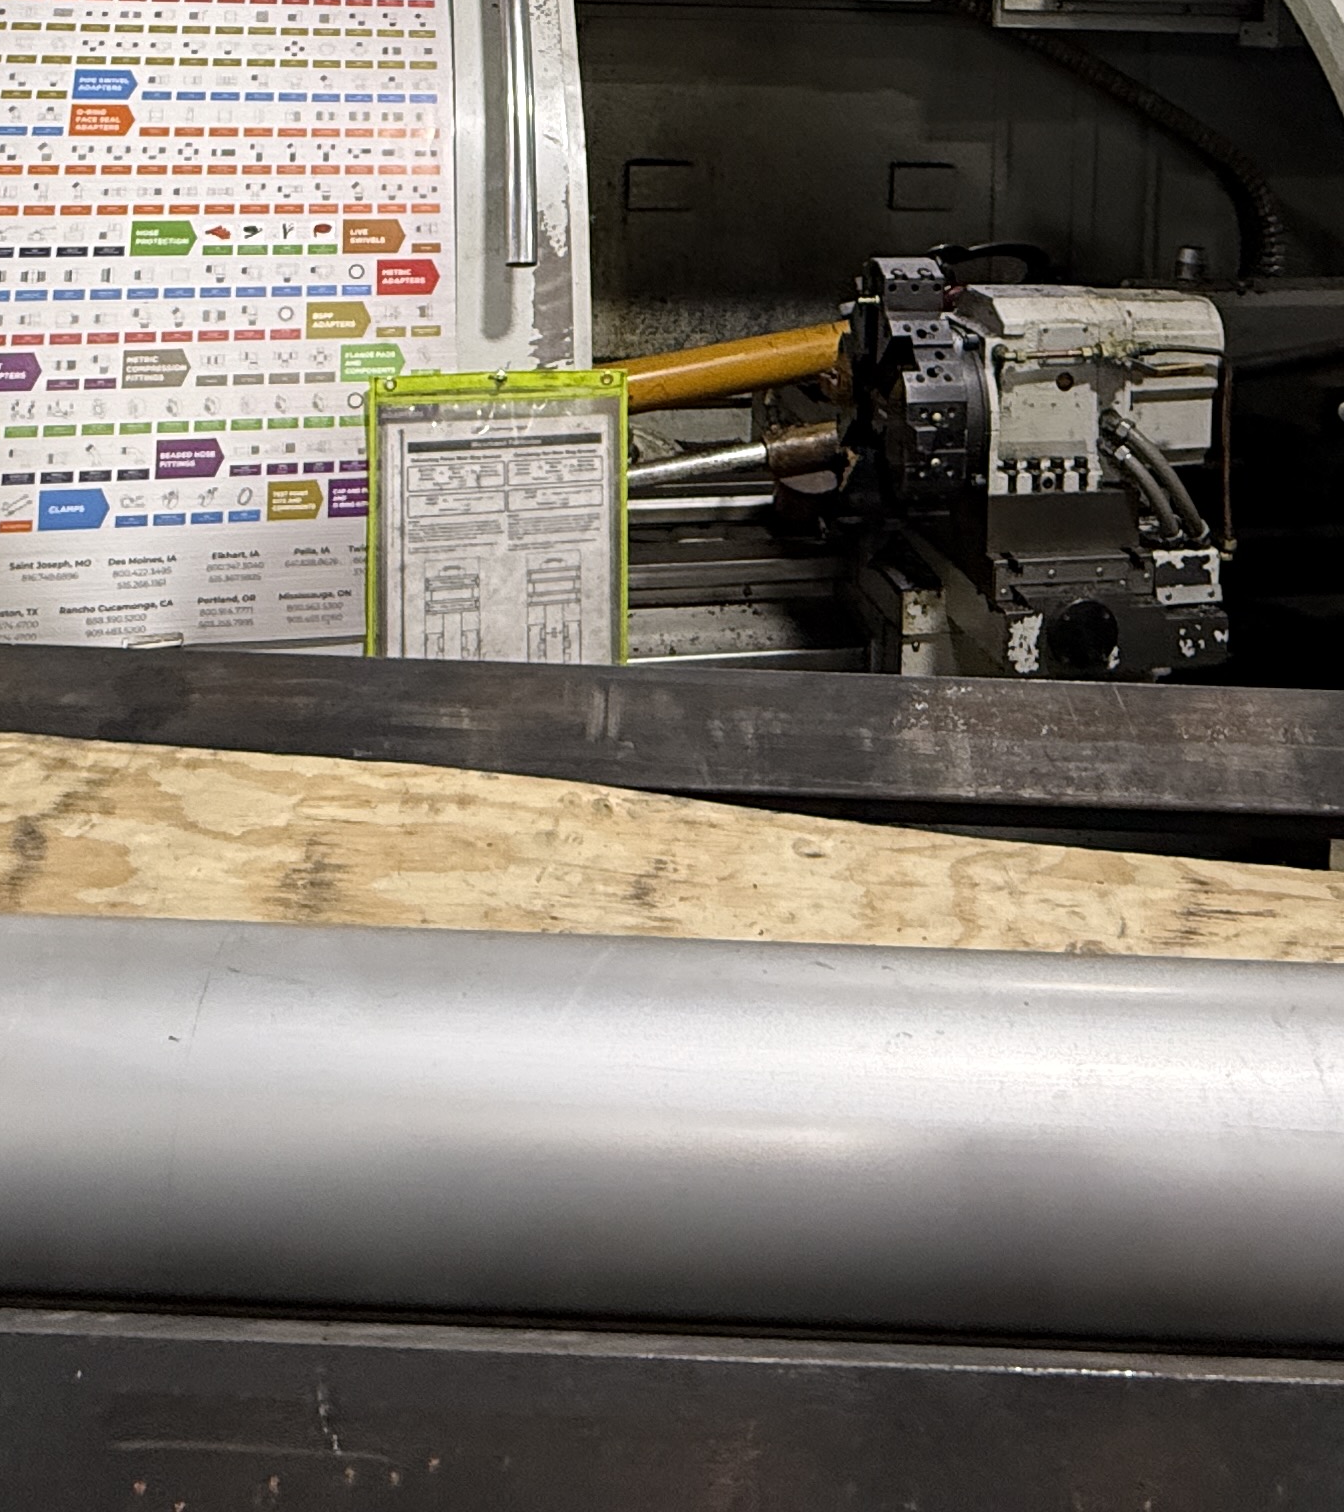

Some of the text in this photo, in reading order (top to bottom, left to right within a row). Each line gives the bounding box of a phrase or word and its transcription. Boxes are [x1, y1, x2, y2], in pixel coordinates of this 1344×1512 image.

[349, 228, 368, 236] LIVE
[134, 236, 189, 245] PROTECTION
[350, 236, 386, 244] SWIVELS
[382, 268, 412, 276] METRIC
[382, 276, 426, 285] ADAPTERS
[311, 320, 356, 329] ADAPTERS
[126, 355, 159, 364] METRIC
[126, 364, 188, 373] COMPRESSION
[344, 366, 396, 376] COMPONENTS
[125, 373, 164, 382] FITTINGS
[159, 450, 216, 460] BEADED HOSE
[159, 459, 196, 468] FITTINGS
[48, 504, 85, 515] CLAMPS
[320, 546, 330, 554] IA
[212, 550, 260, 560] Elkhart, IA
[9, 559, 92, 571] Saint Joseph, MO
[108, 554, 177, 567] Des Moines, IA
[337, 589, 352, 598] ON
[197, 595, 240, 605] Portland,
[59, 599, 174, 614] Rancho Cucamonga, CA
[26, 608, 39, 616] TX
